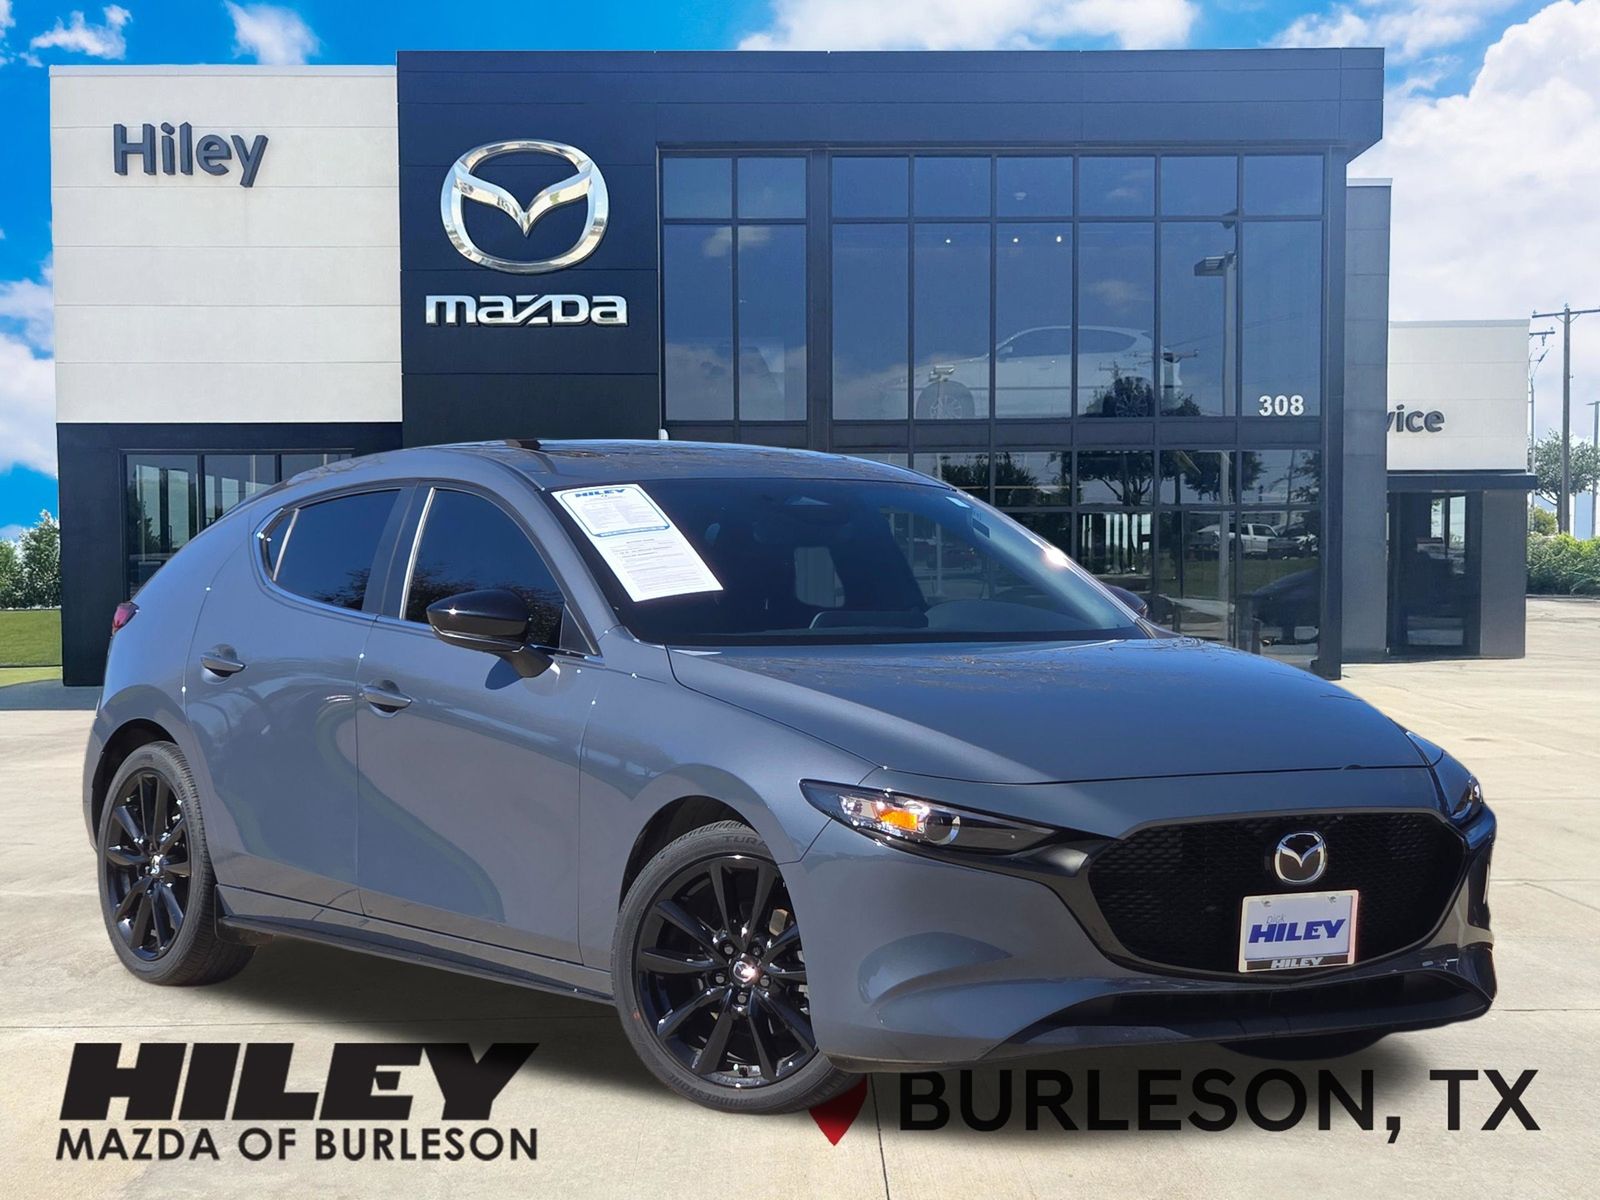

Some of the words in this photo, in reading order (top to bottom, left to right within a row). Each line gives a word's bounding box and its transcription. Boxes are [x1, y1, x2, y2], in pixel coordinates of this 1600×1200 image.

[113, 121, 268, 188] Hiley
[1258, 395, 1305, 416] 308
[1248, 919, 1346, 943] HILEY
[1271, 957, 1323, 970] HILEY
